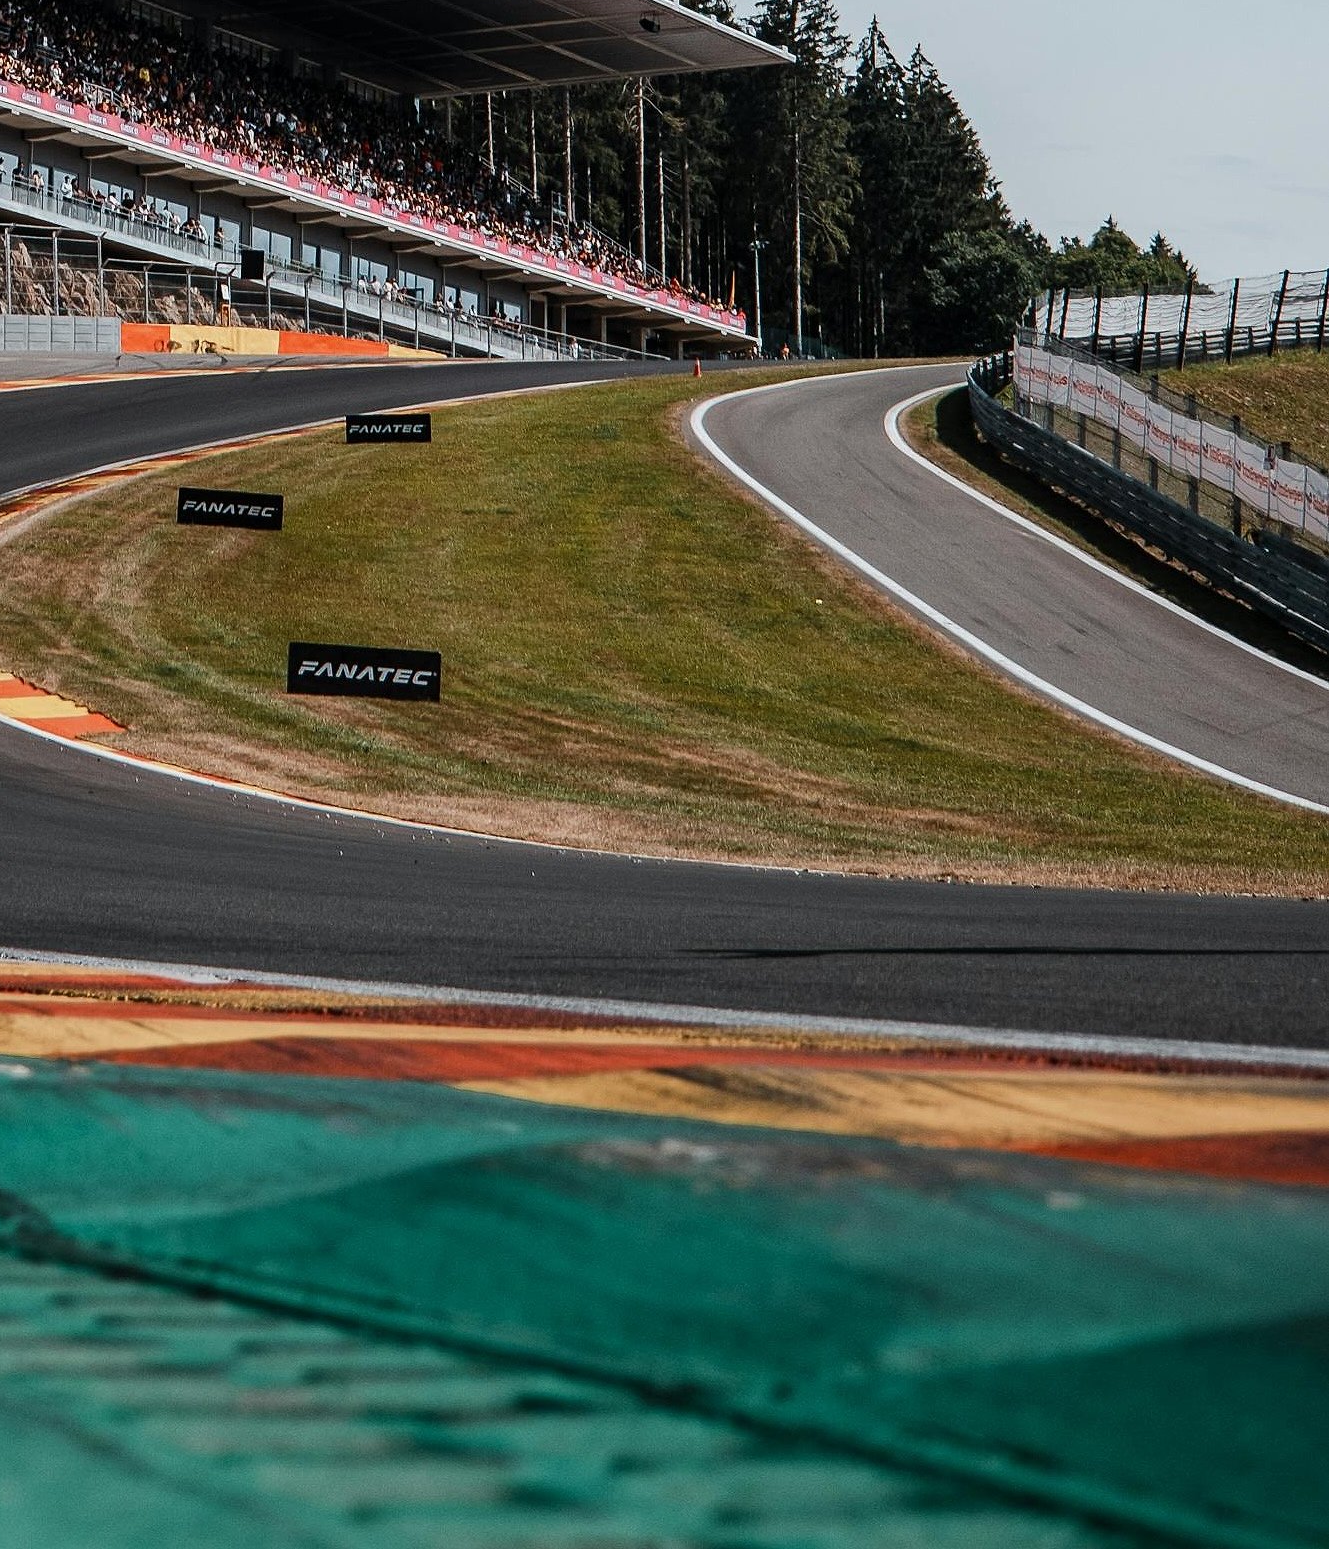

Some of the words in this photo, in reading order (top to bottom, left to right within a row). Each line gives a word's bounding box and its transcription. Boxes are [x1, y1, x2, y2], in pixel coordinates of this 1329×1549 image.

[349, 424, 424, 434] FANATEC
[182, 500, 275, 518] FANATEC
[298, 660, 433, 686] FANATEC
